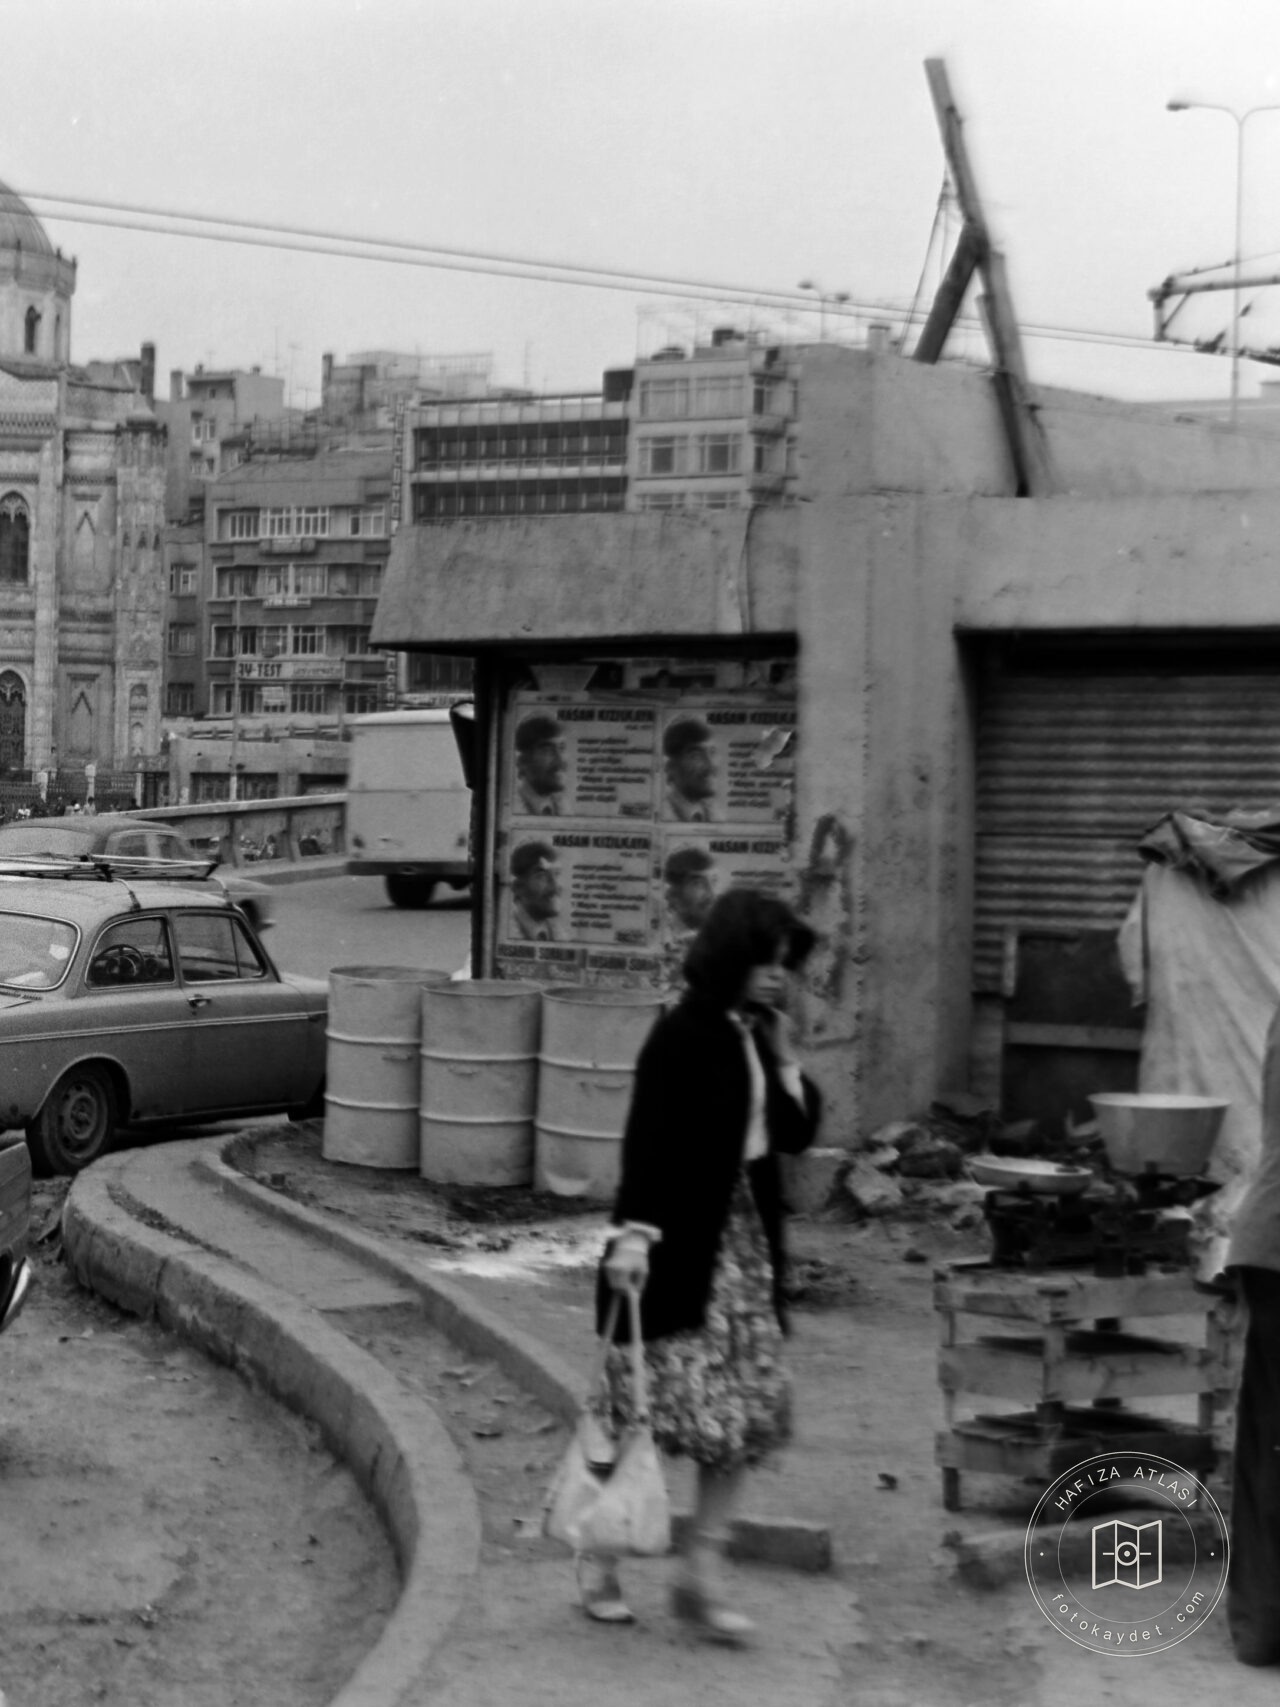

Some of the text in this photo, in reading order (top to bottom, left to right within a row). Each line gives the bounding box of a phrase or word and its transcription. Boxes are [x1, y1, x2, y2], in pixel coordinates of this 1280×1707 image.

[557, 709, 595, 721] HASAN
[707, 712, 746, 724] HASAN
[553, 835, 650, 849] HASAN KIZILKAYA
[709, 841, 749, 853] HASAN
